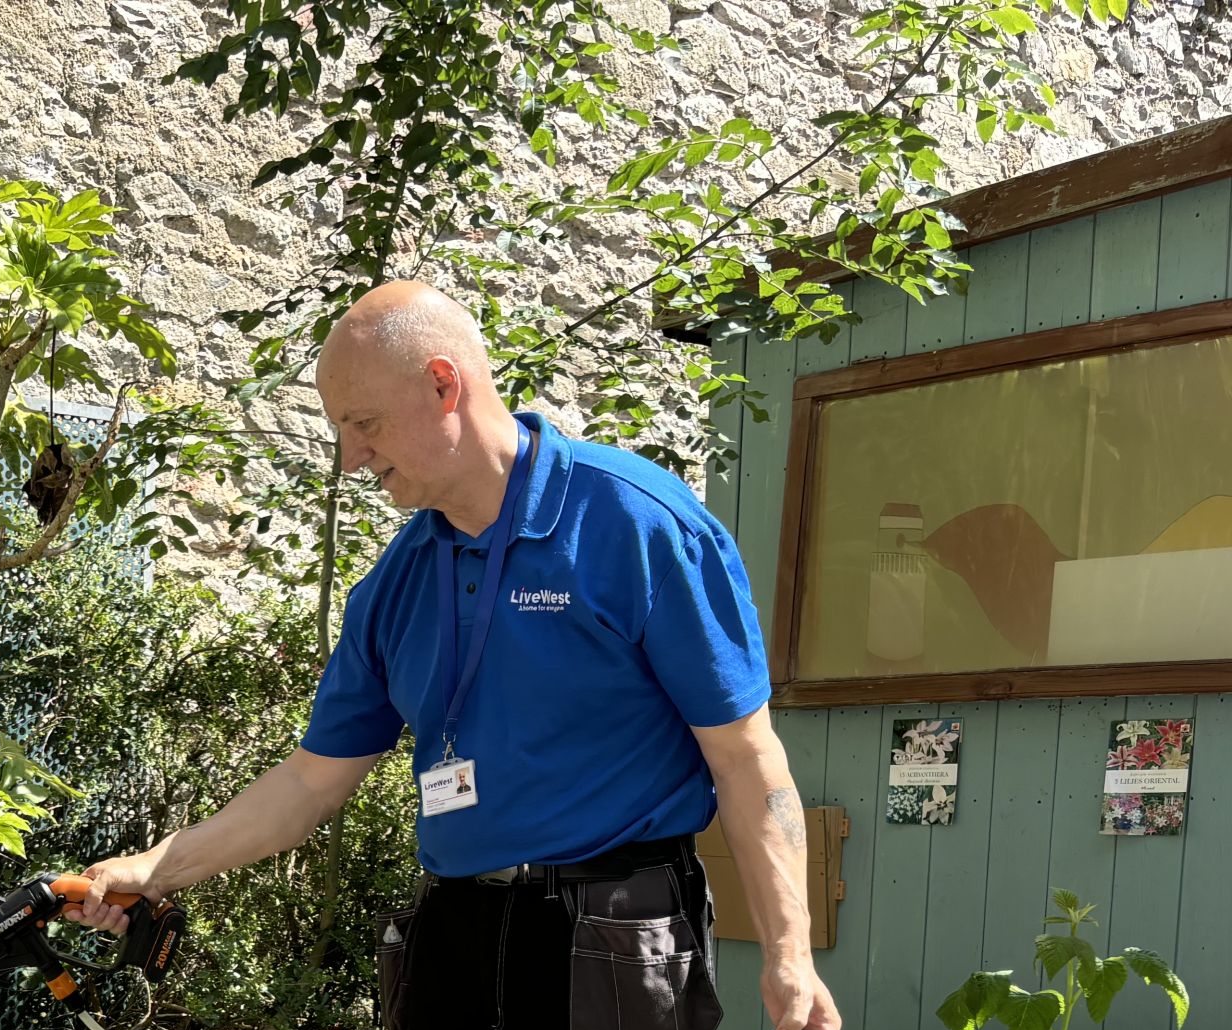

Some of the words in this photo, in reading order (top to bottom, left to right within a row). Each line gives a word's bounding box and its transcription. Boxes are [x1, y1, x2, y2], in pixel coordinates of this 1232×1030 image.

[510, 587, 571, 604] LiveWest
[424, 777, 453, 791] LiveWest
[155, 944, 171, 969] 20V
